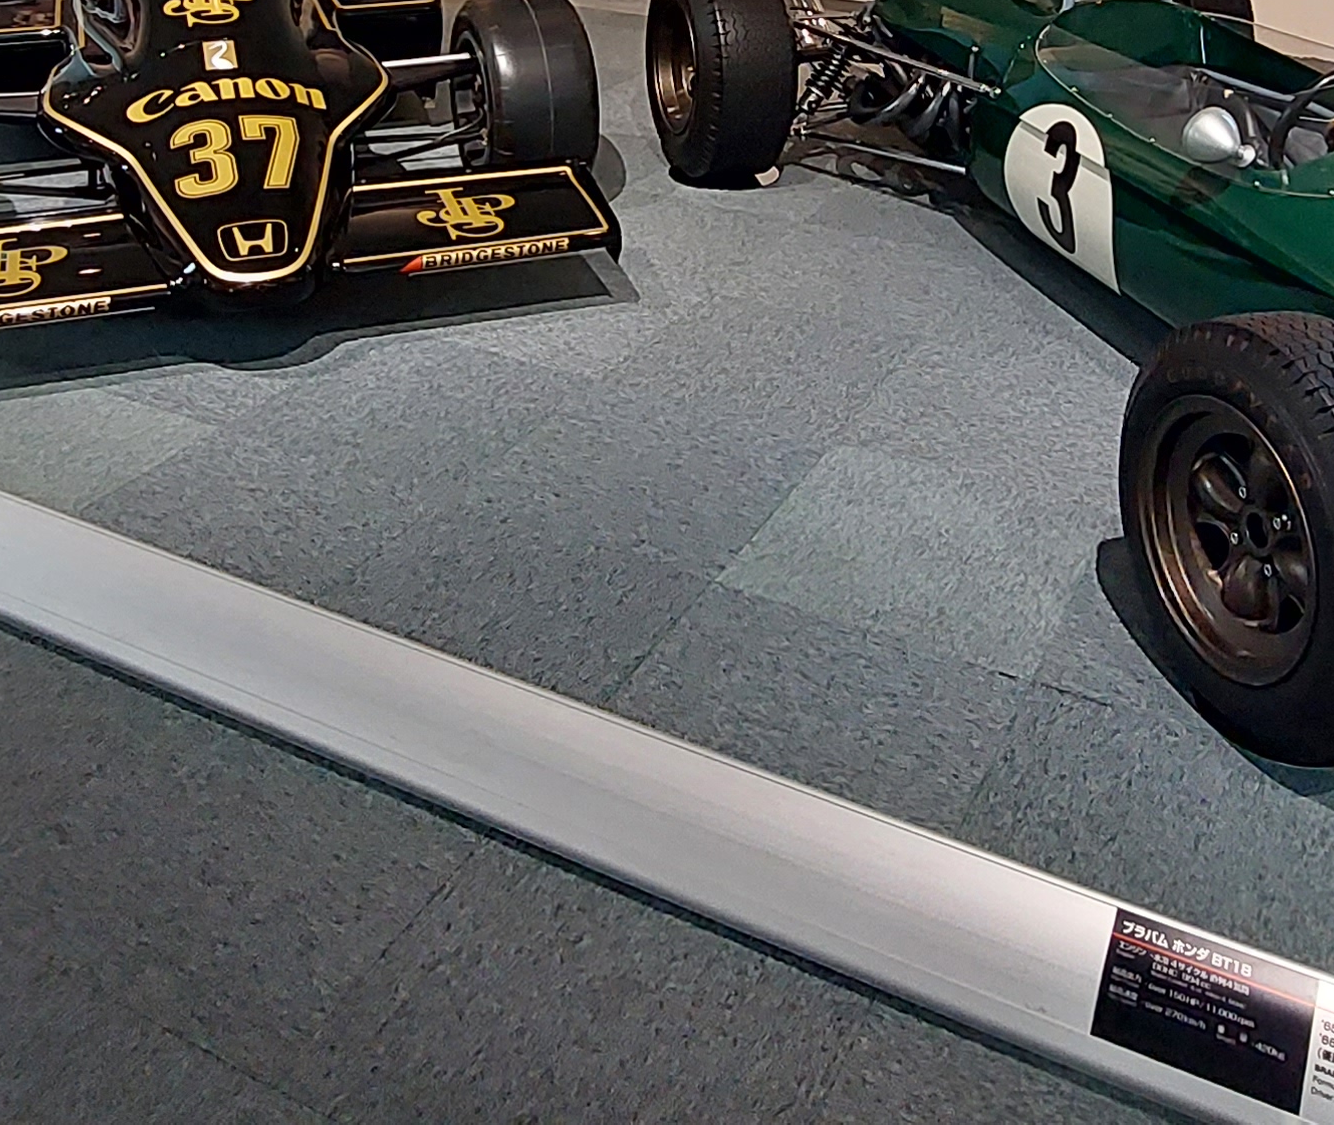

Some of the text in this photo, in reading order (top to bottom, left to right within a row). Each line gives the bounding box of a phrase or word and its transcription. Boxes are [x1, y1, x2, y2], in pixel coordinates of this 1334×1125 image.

[126, 77, 327, 123] Canon
[170, 115, 300, 199] 37
[1037, 120, 1081, 254] 3
[425, 240, 567, 269] BRIDGESTONE
[1122, 921, 1252, 977] ブラバム ホンダ BT18
